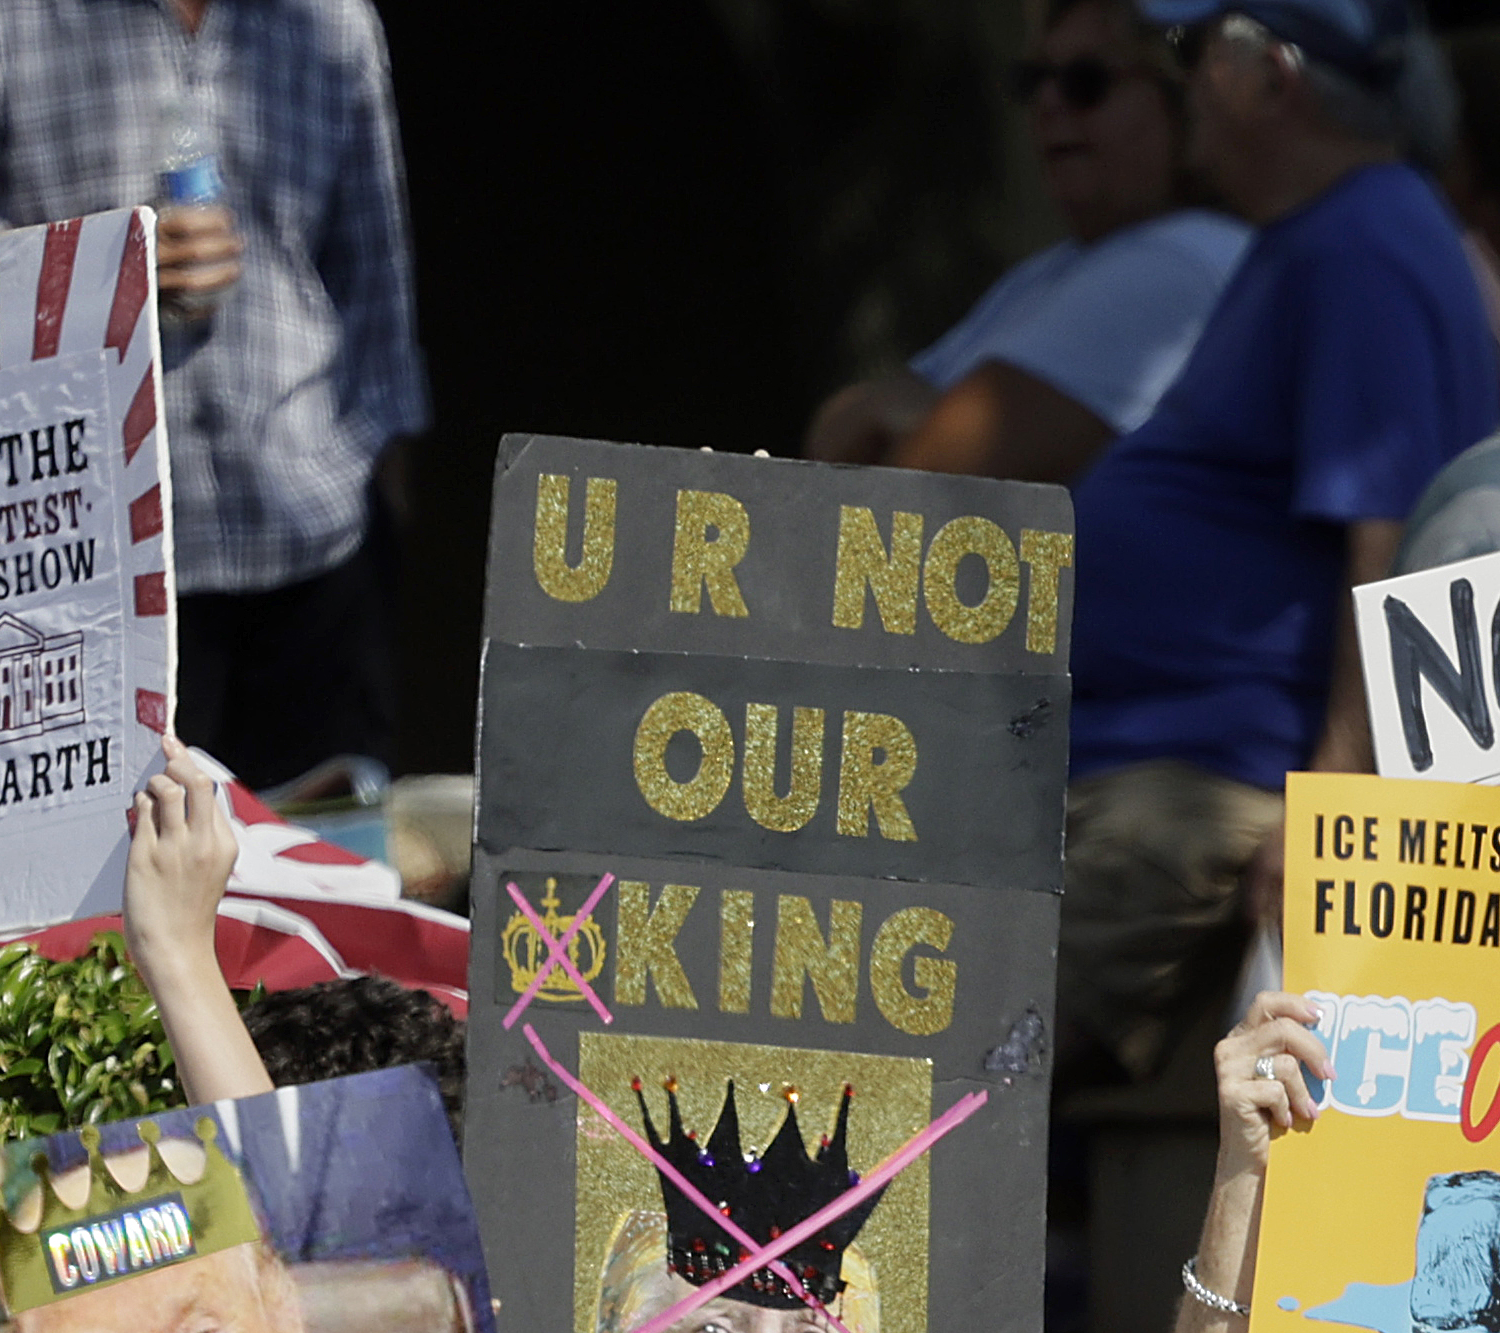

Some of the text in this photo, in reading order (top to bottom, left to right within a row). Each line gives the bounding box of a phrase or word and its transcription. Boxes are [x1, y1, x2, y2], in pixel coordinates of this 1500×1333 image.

[532, 473, 1073, 654] U R NOT
[632, 690, 919, 842] OUR
[1314, 814, 1379, 861] ICE
[614, 879, 957, 1036] KING
[49, 1202, 192, 1286] COWARD
